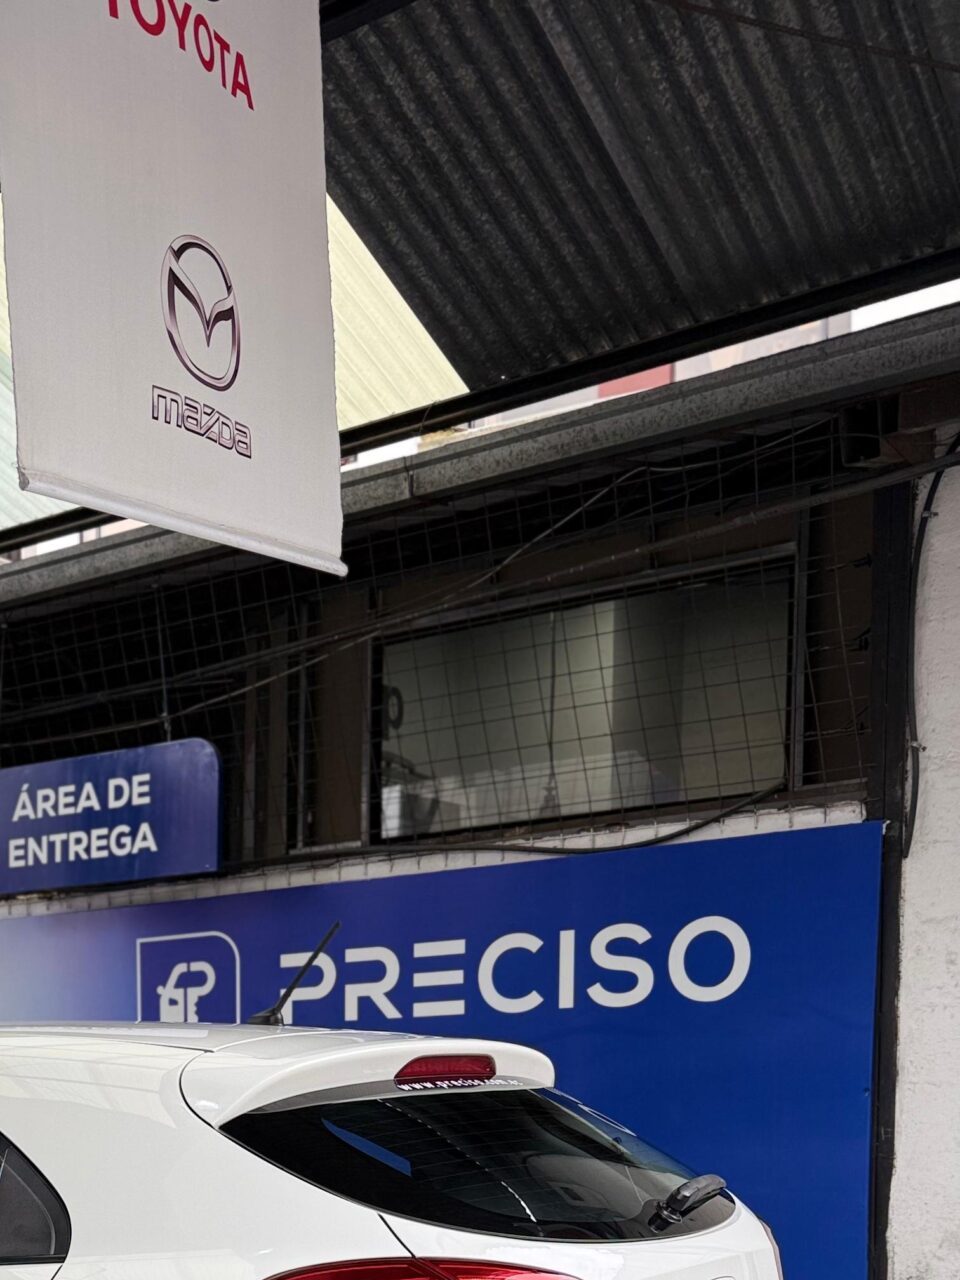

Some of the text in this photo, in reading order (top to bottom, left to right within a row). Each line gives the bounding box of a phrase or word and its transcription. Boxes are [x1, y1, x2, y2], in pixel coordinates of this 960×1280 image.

[11, 773, 151, 822] ÁREA DE
[8, 823, 157, 869] ENTREGA
[279, 915, 752, 1024] PRECISO
